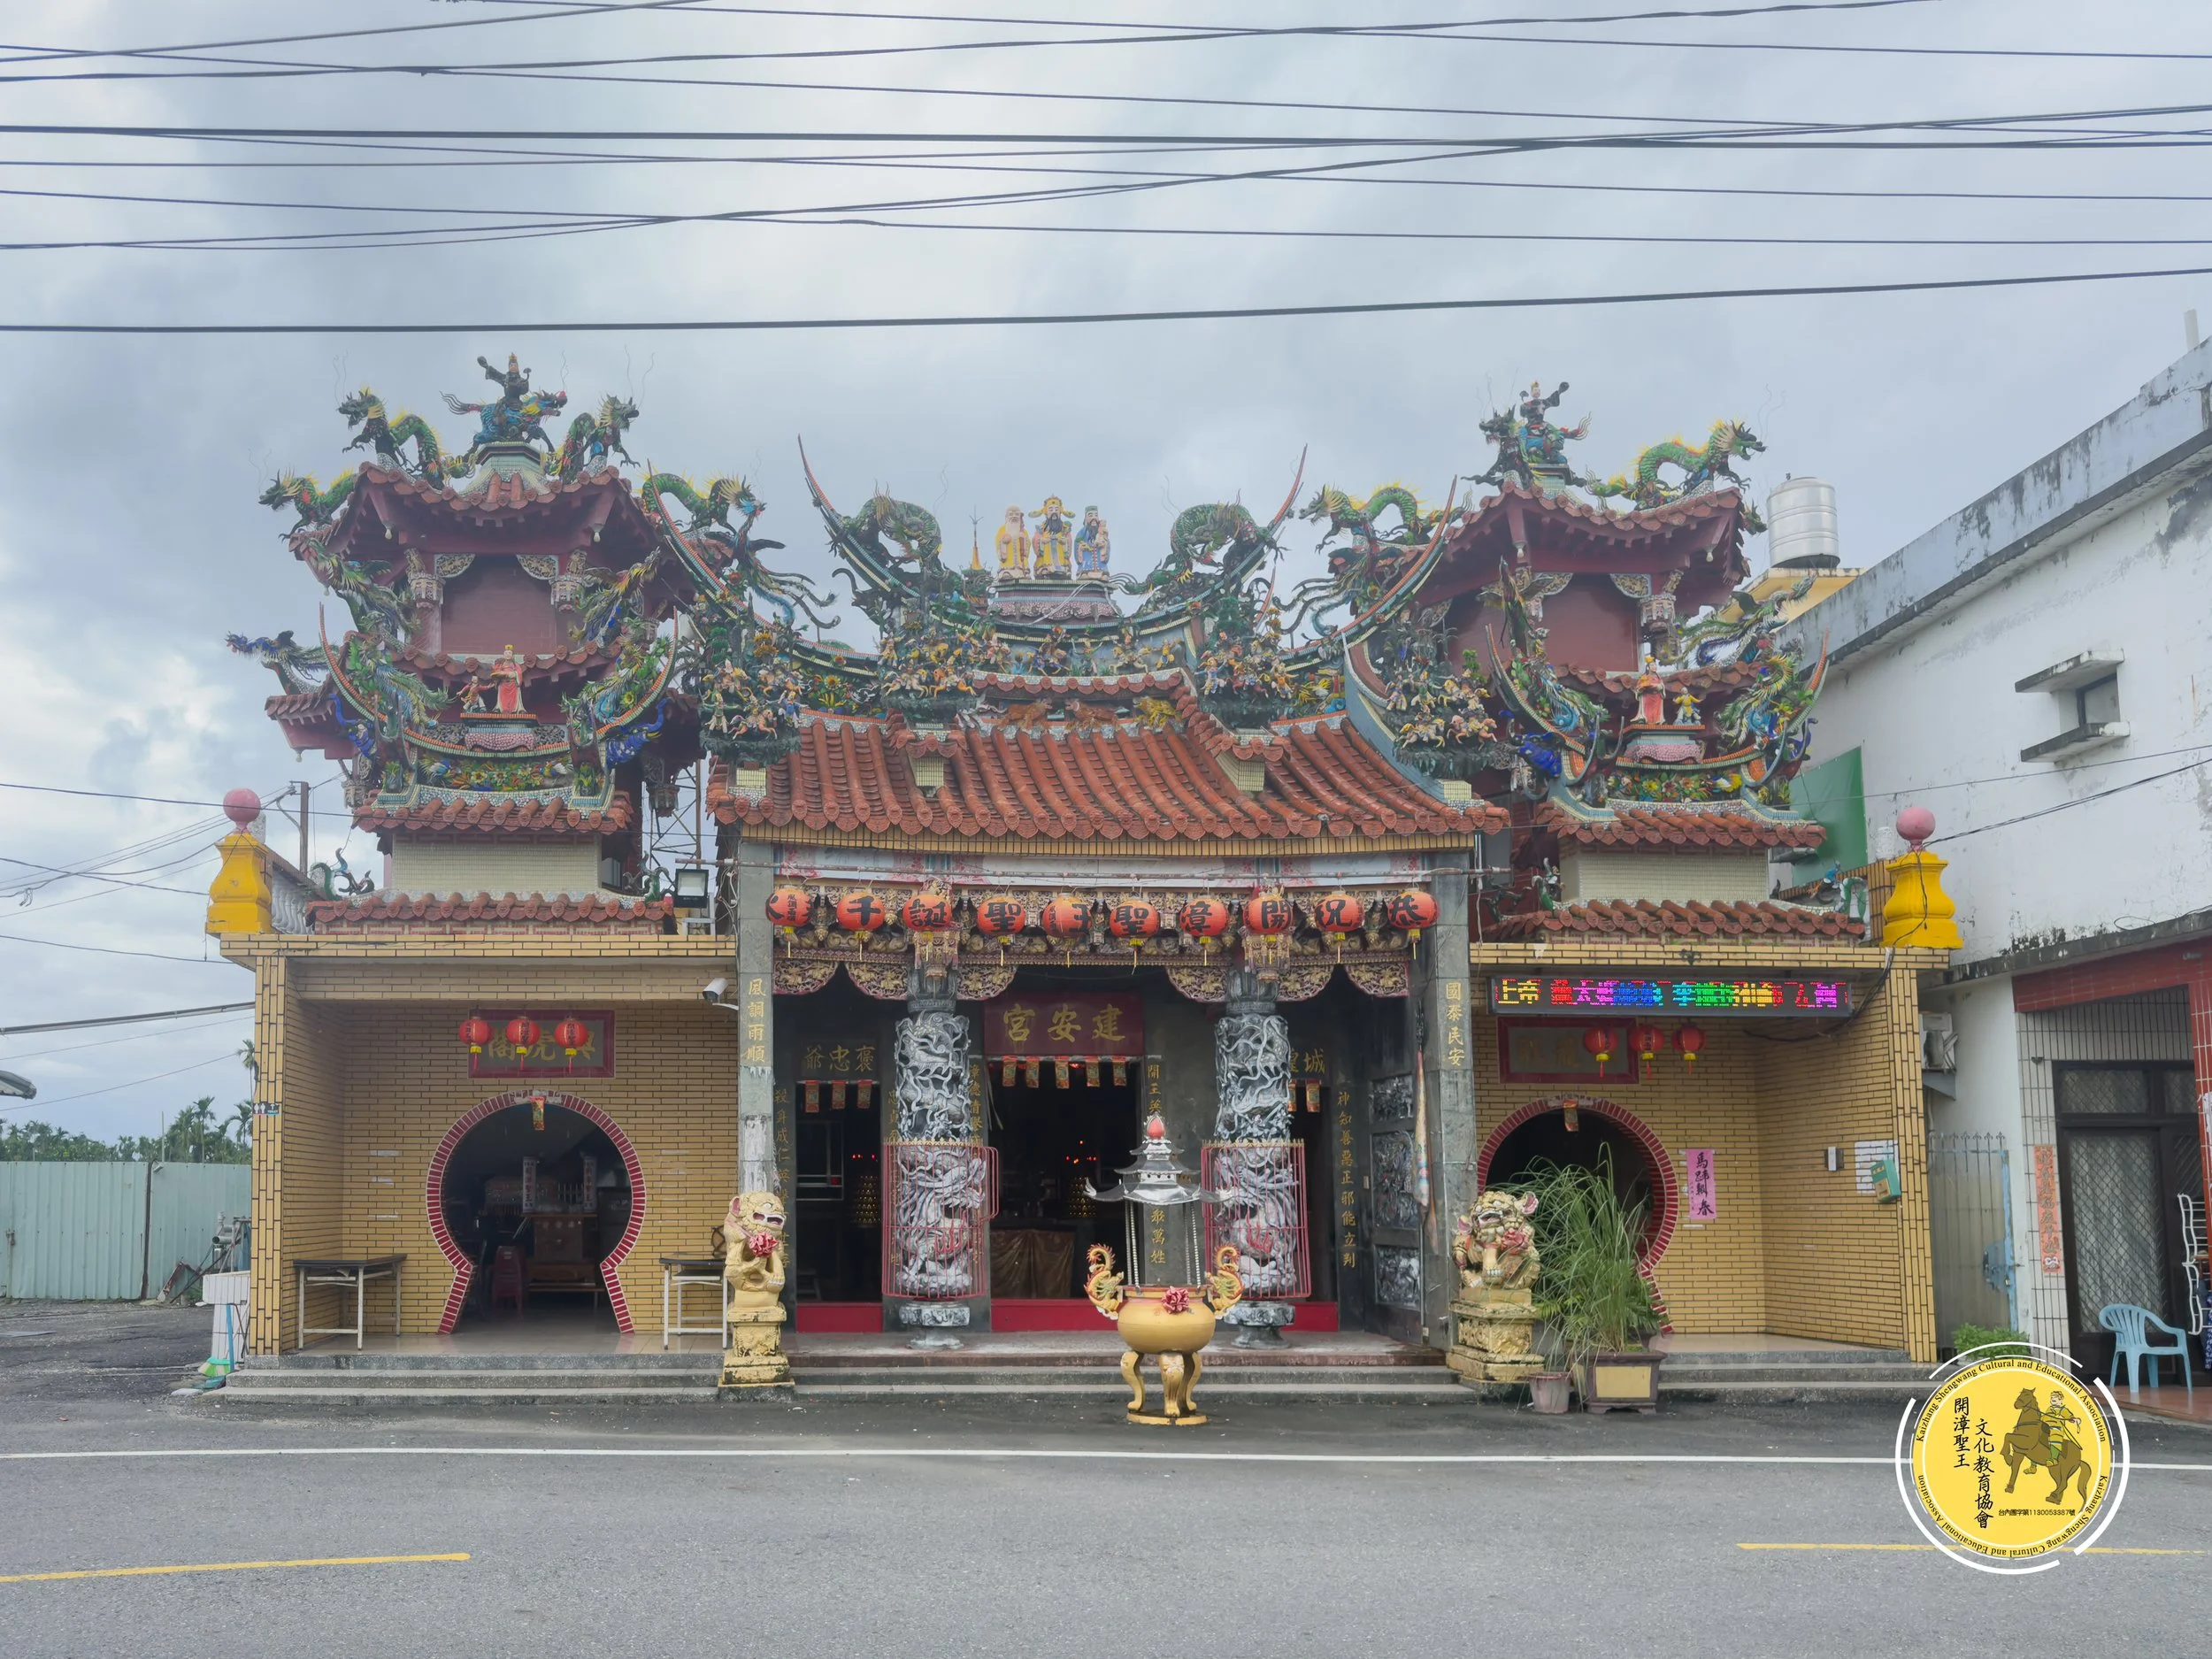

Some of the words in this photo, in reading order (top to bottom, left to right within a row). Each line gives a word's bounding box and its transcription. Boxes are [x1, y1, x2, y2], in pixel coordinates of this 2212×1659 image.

[744, 978, 767, 1063] 風調雨順
[1002, 1002, 1126, 1042] 建安宮
[1446, 982, 1465, 1067] 國泰民安
